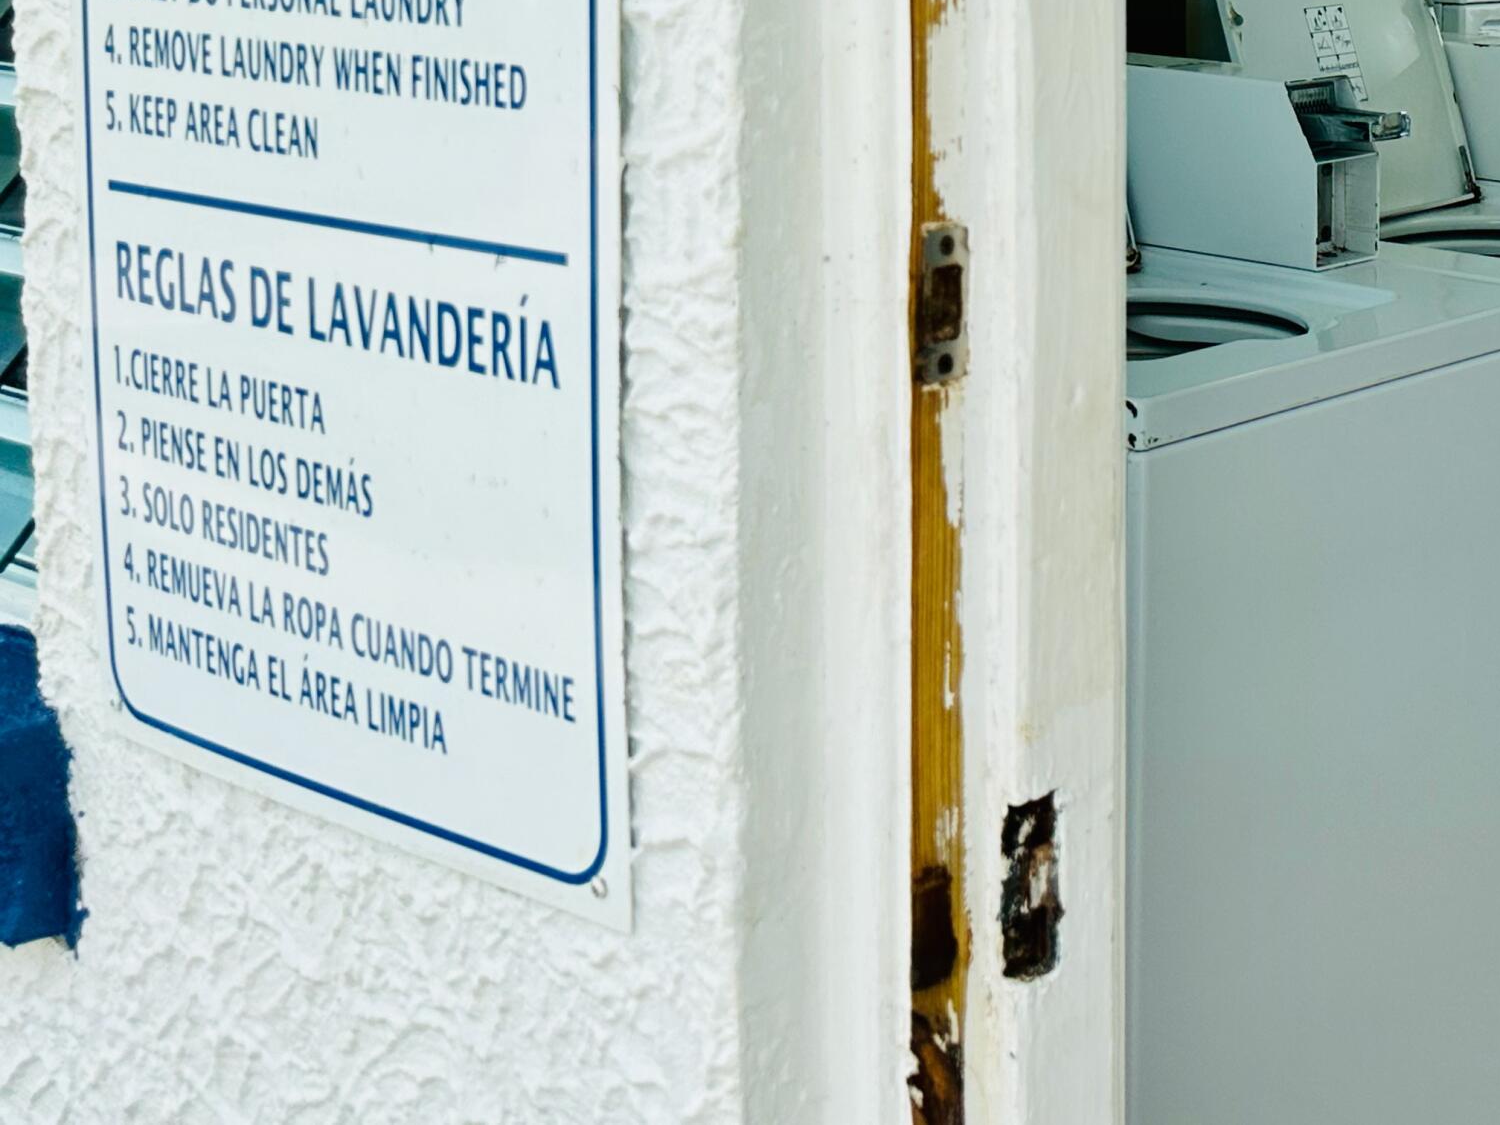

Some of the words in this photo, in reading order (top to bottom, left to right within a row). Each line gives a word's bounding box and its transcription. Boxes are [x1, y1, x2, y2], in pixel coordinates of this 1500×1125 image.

[103, 23, 122, 65] 4.
[128, 25, 213, 76] REMOVE
[219, 35, 325, 88] LAUNDRY
[332, 46, 402, 97] WHEN
[410, 53, 528, 111] FINISHED
[105, 89, 123, 132] 5.
[128, 93, 178, 139] KEEP
[184, 100, 241, 149] AREA
[246, 107, 319, 160] CLEAN
[115, 240, 237, 324] REGLAS
[249, 265, 295, 337] DE
[307, 276, 561, 391] LAVANDERÍA
[206, 366, 233, 412] LA
[239, 373, 326, 435] PUERTA
[116, 409, 135, 454] 2.
[140, 416, 208, 474] PIENSE
[213, 435, 241, 482] EN
[247, 444, 289, 496] LOS
[295, 456, 374, 519] DEMÁS
[119, 474, 137, 518] 3.
[142, 481, 195, 536] SOLO
[201, 499, 330, 577] RESIDENTES
[123, 542, 141, 584] 4.
[146, 548, 243, 618] REMUEVA
[248, 581, 276, 629] LA
[282, 591, 344, 651] ROPA
[350, 612, 454, 685] CUANDO
[461, 645, 577, 724] TERMINE
[125, 604, 143, 648] 5.
[147, 613, 261, 691] MANTENGA
[266, 654, 293, 703] EL
[299, 654, 360, 726] ÁREA
[366, 688, 448, 755] LIMPIA
